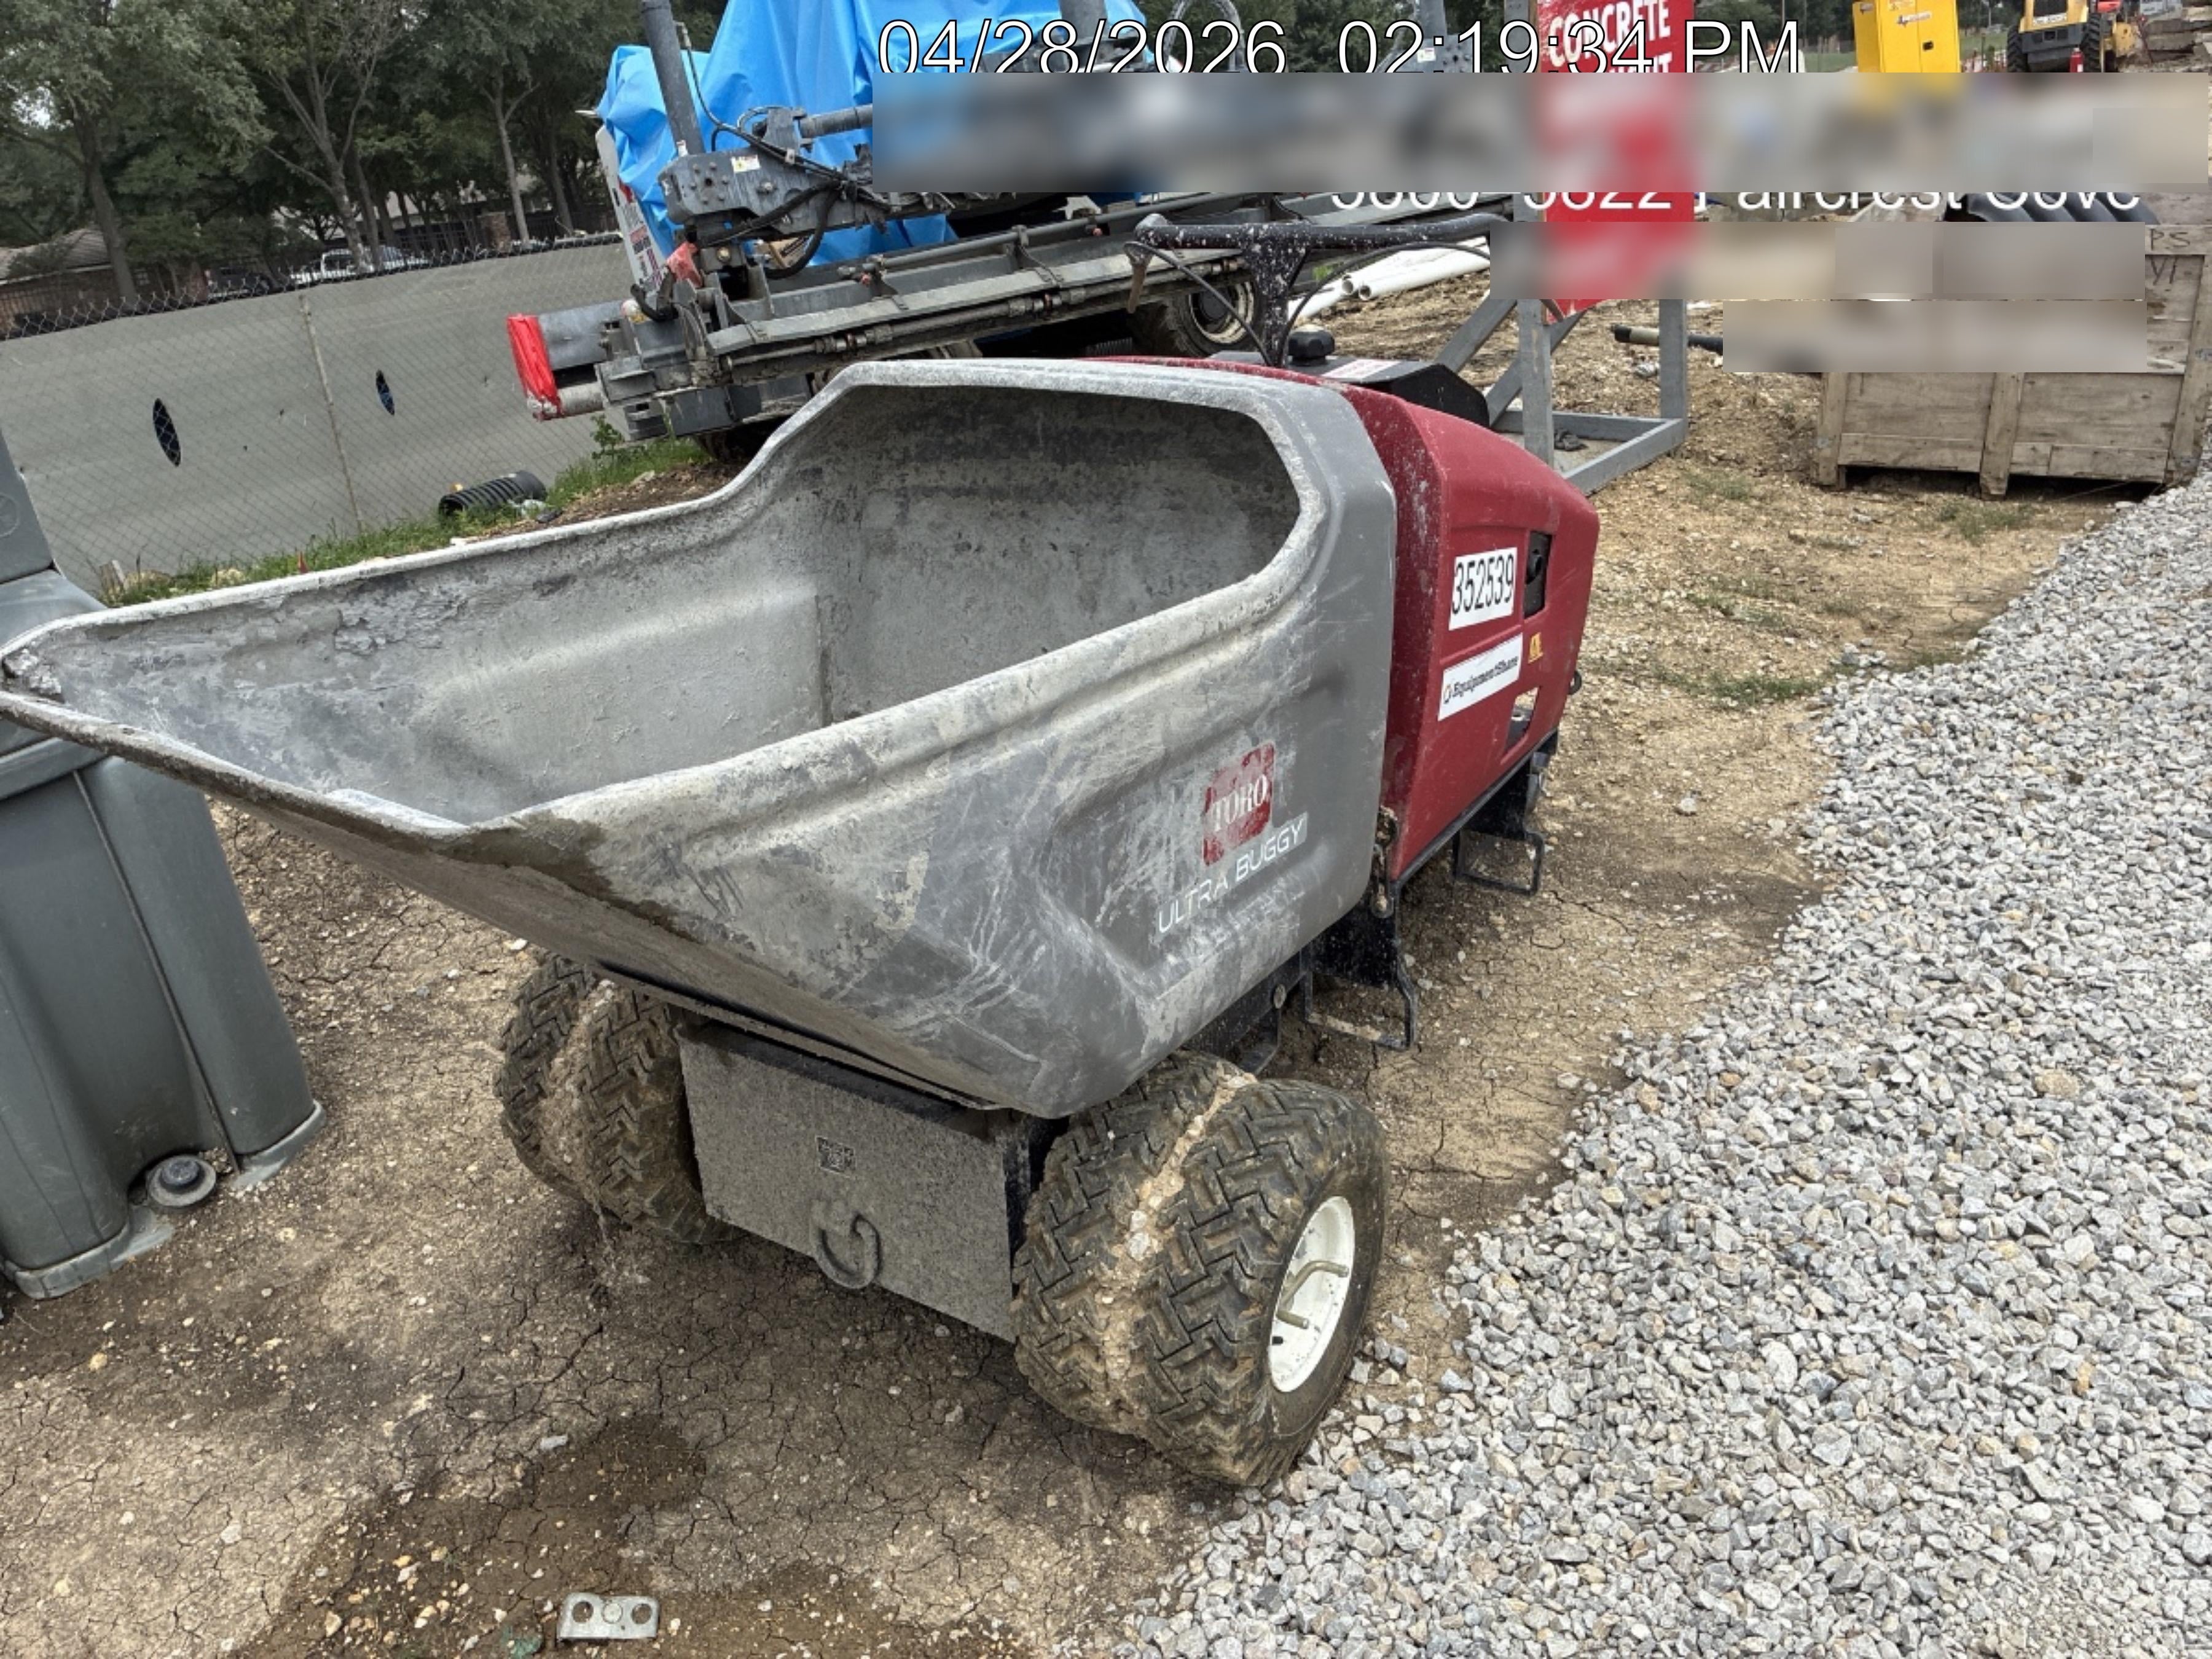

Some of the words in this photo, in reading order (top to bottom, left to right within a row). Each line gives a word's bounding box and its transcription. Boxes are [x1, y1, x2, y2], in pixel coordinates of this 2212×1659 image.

[1451, 553, 1515, 614] 352539
[1211, 774, 1269, 832] TORO
[1158, 875, 1229, 933] ULTRA
[1236, 817, 1306, 882] BUGGY
